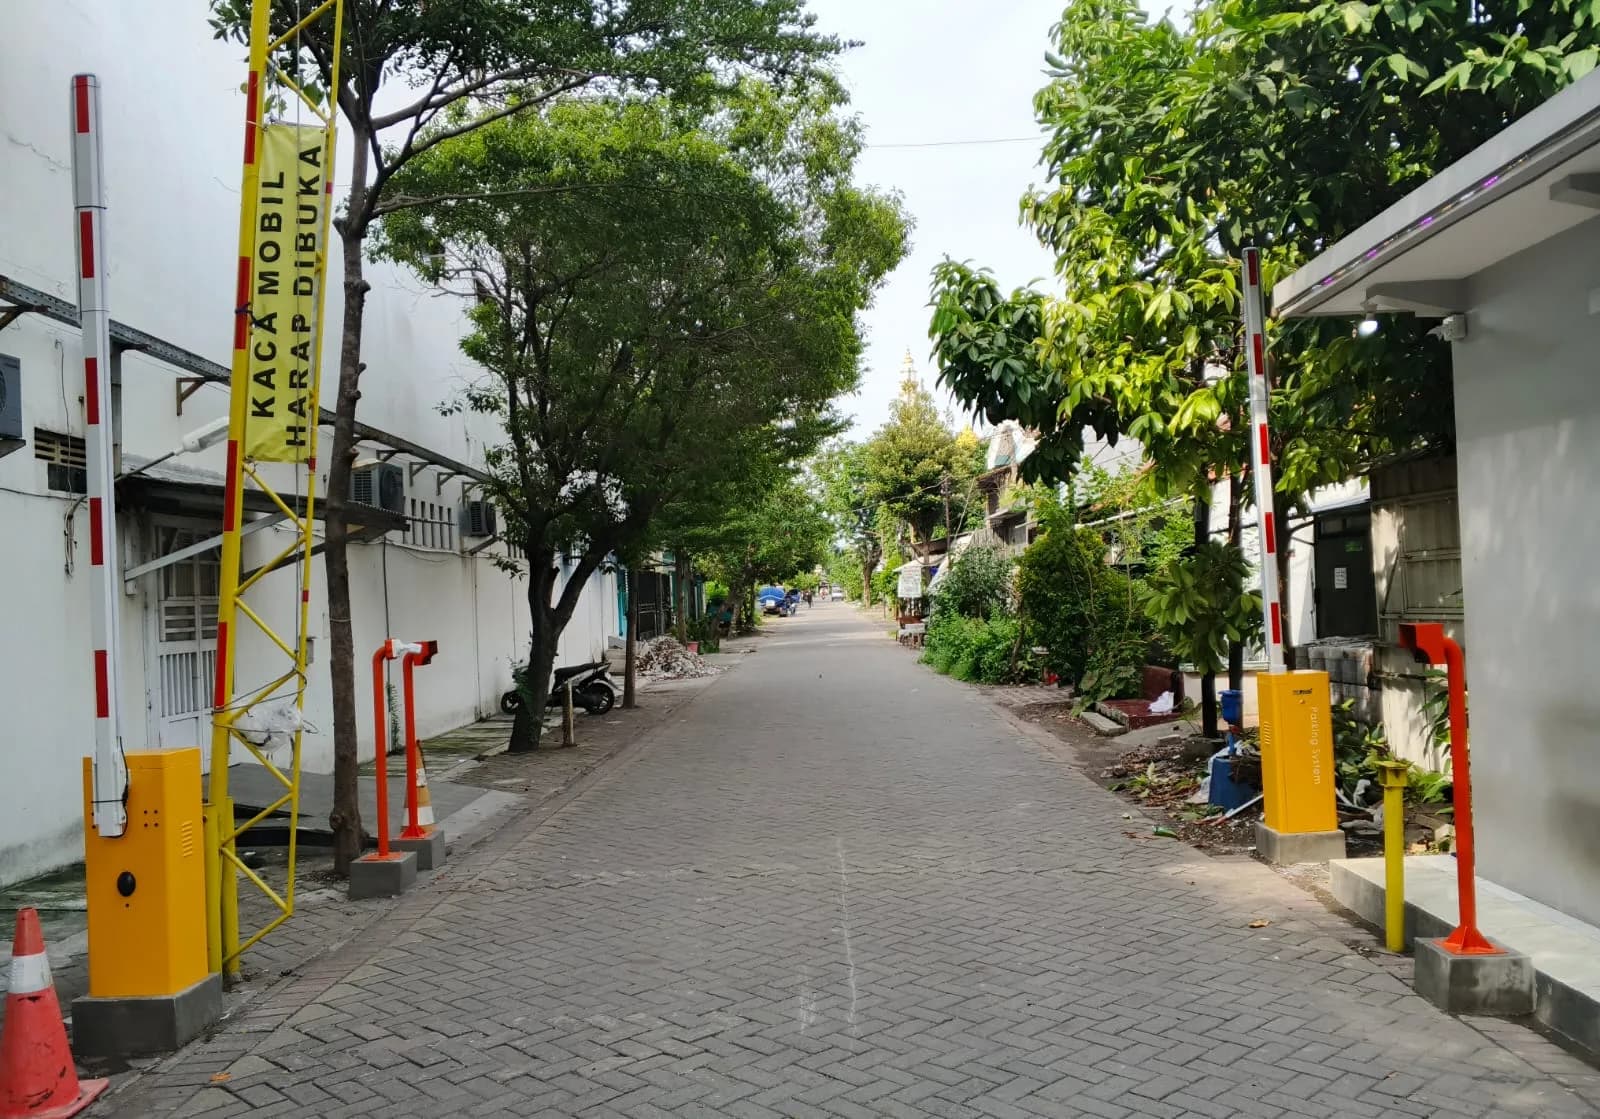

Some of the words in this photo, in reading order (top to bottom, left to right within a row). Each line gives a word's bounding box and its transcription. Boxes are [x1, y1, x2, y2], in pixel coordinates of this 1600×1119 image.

[258, 171, 285, 295] MOBIL
[293, 145, 322, 296] DIBUKA
[252, 312, 278, 418] KACA
[286, 313, 311, 446] HARAP
[1310, 706, 1320, 746] Parking
[1312, 748, 1321, 785] System
